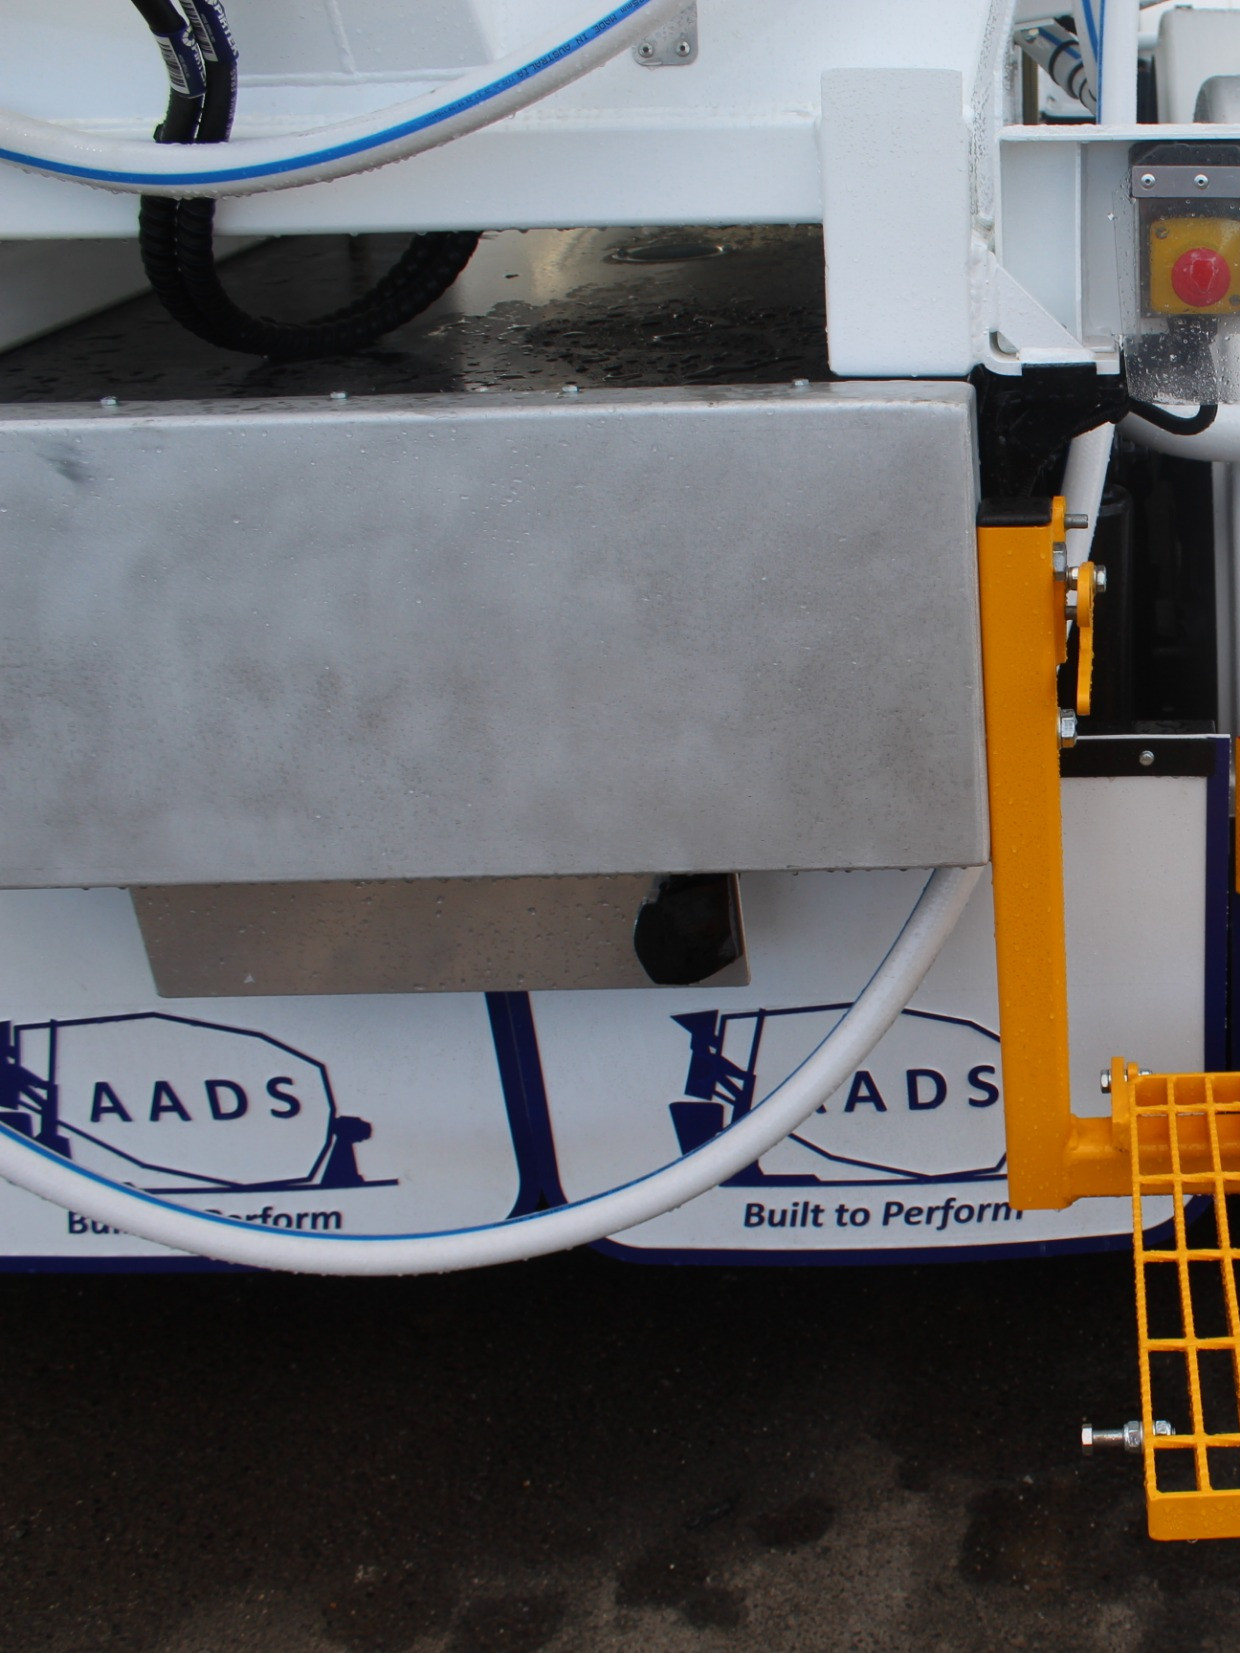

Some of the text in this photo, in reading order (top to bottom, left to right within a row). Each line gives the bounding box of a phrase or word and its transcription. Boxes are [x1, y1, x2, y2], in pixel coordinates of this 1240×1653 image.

[575, 33, 588, 46] IN
[592, 14, 618, 34] MADE
[516, 44, 571, 80] AUSTRALIA
[90, 1076, 302, 1122] AADS
[814, 1064, 1000, 1113] ADS
[743, 1197, 1024, 1231] Built to Perform
